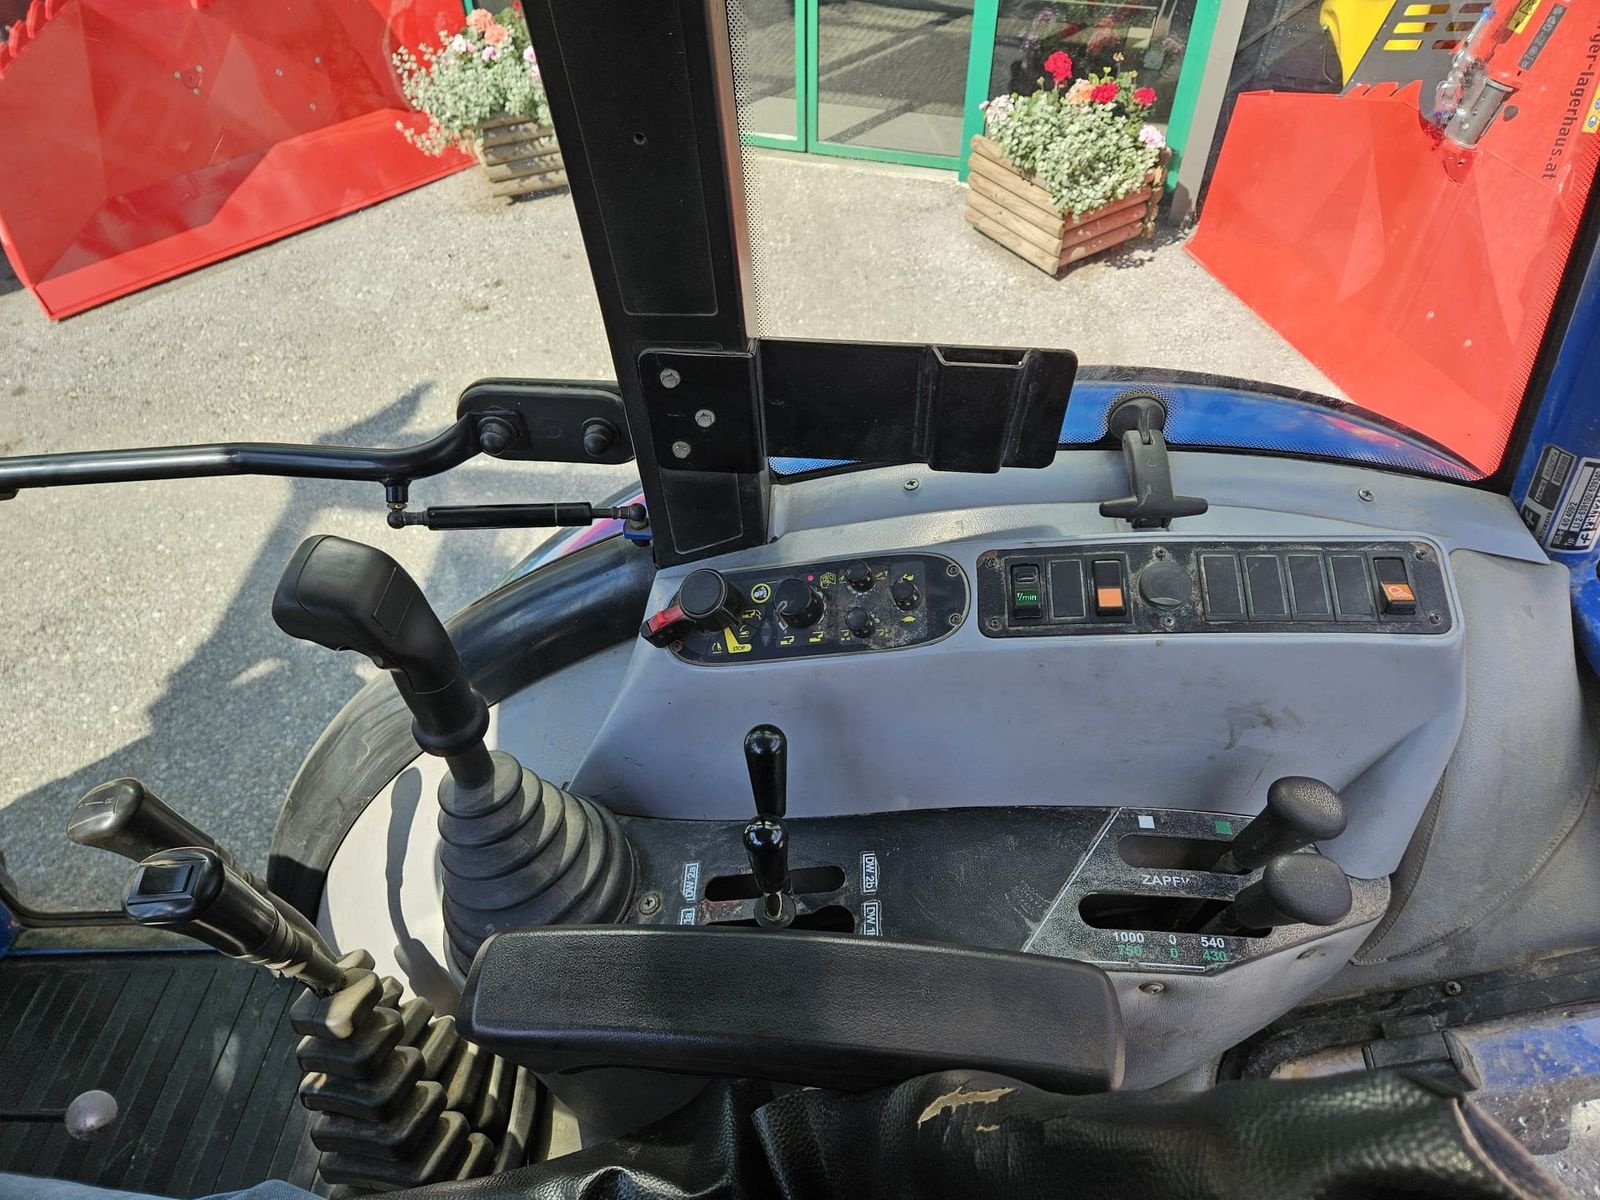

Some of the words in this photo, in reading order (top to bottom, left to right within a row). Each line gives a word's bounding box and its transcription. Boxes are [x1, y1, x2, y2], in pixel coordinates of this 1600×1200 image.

[865, 856, 875, 873] DW
[866, 875, 876, 889] 2b
[866, 906, 876, 925] DW
[1113, 931, 1145, 943] 1000
[1168, 934, 1177, 945] 0
[1201, 936, 1225, 948] 540
[1118, 943, 1143, 957] 750
[1170, 947, 1179, 959] 0
[1202, 950, 1228, 961] 430
